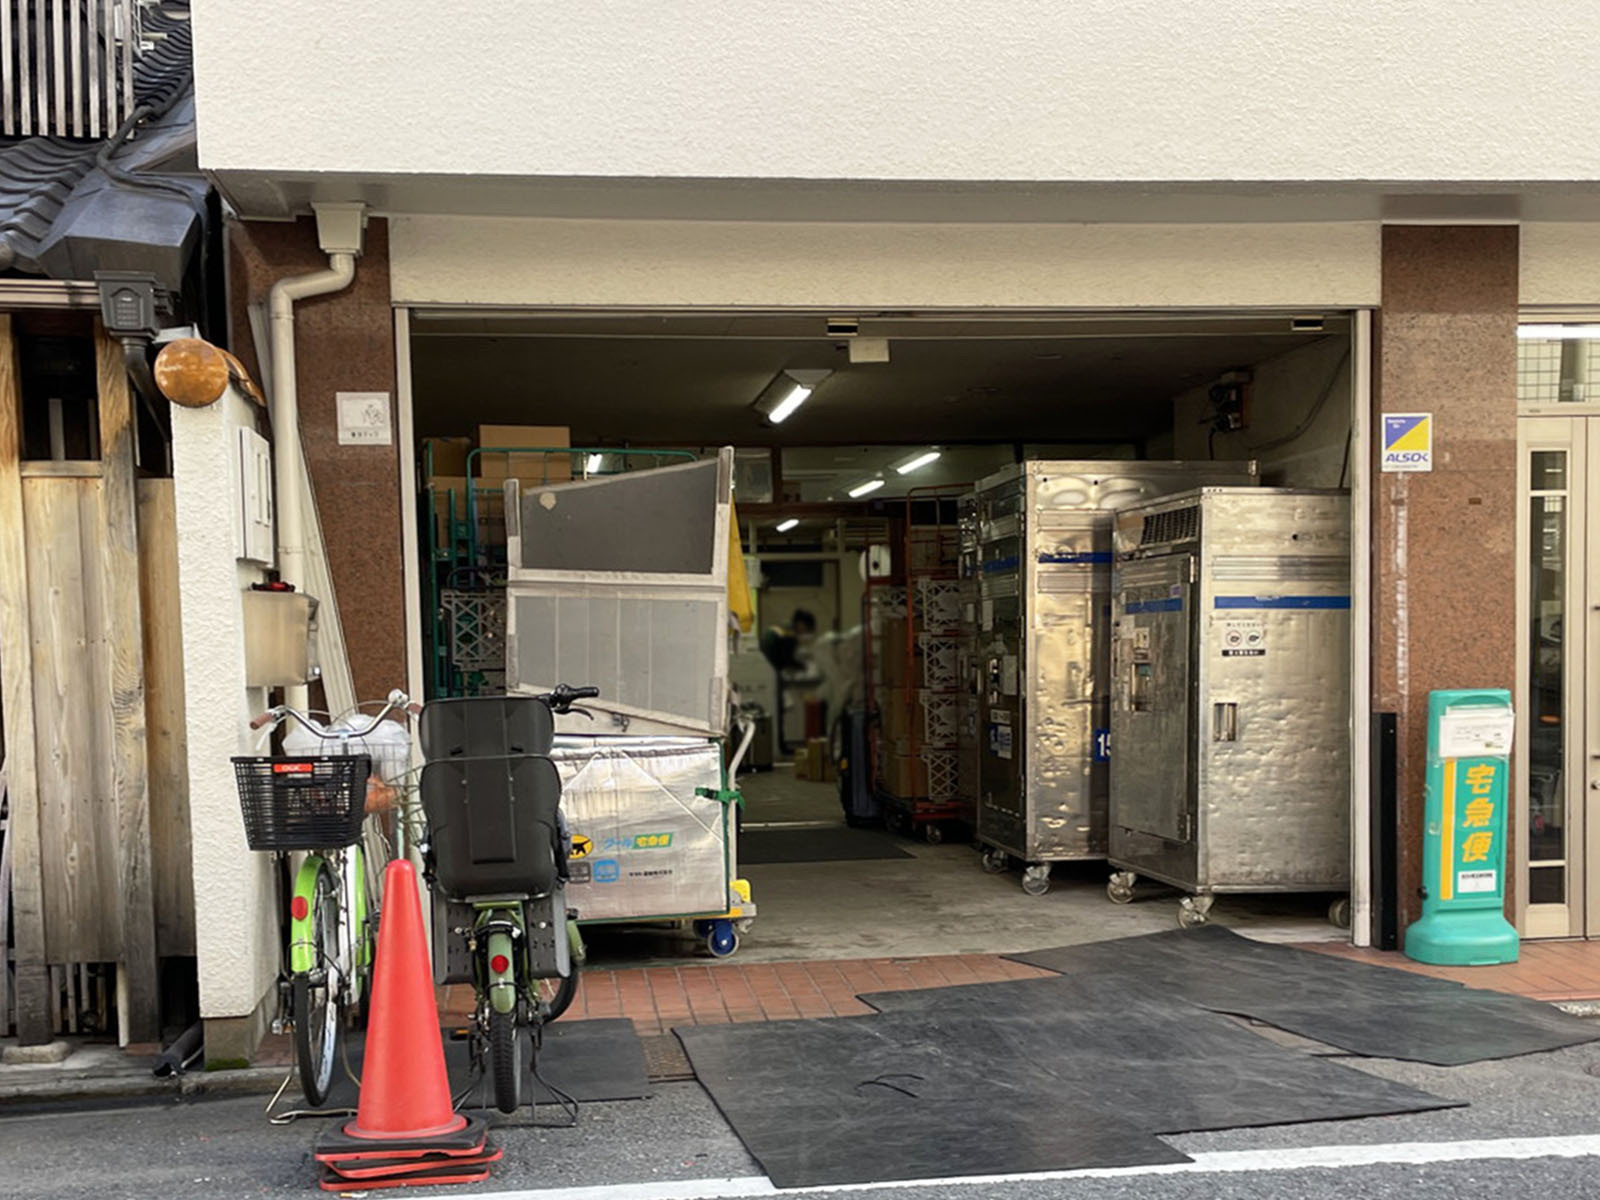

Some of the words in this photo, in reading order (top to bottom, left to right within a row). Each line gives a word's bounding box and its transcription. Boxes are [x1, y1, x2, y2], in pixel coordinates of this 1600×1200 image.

[1385, 452, 1428, 463] ALSOK
[1462, 763, 1496, 863] 宅急便
